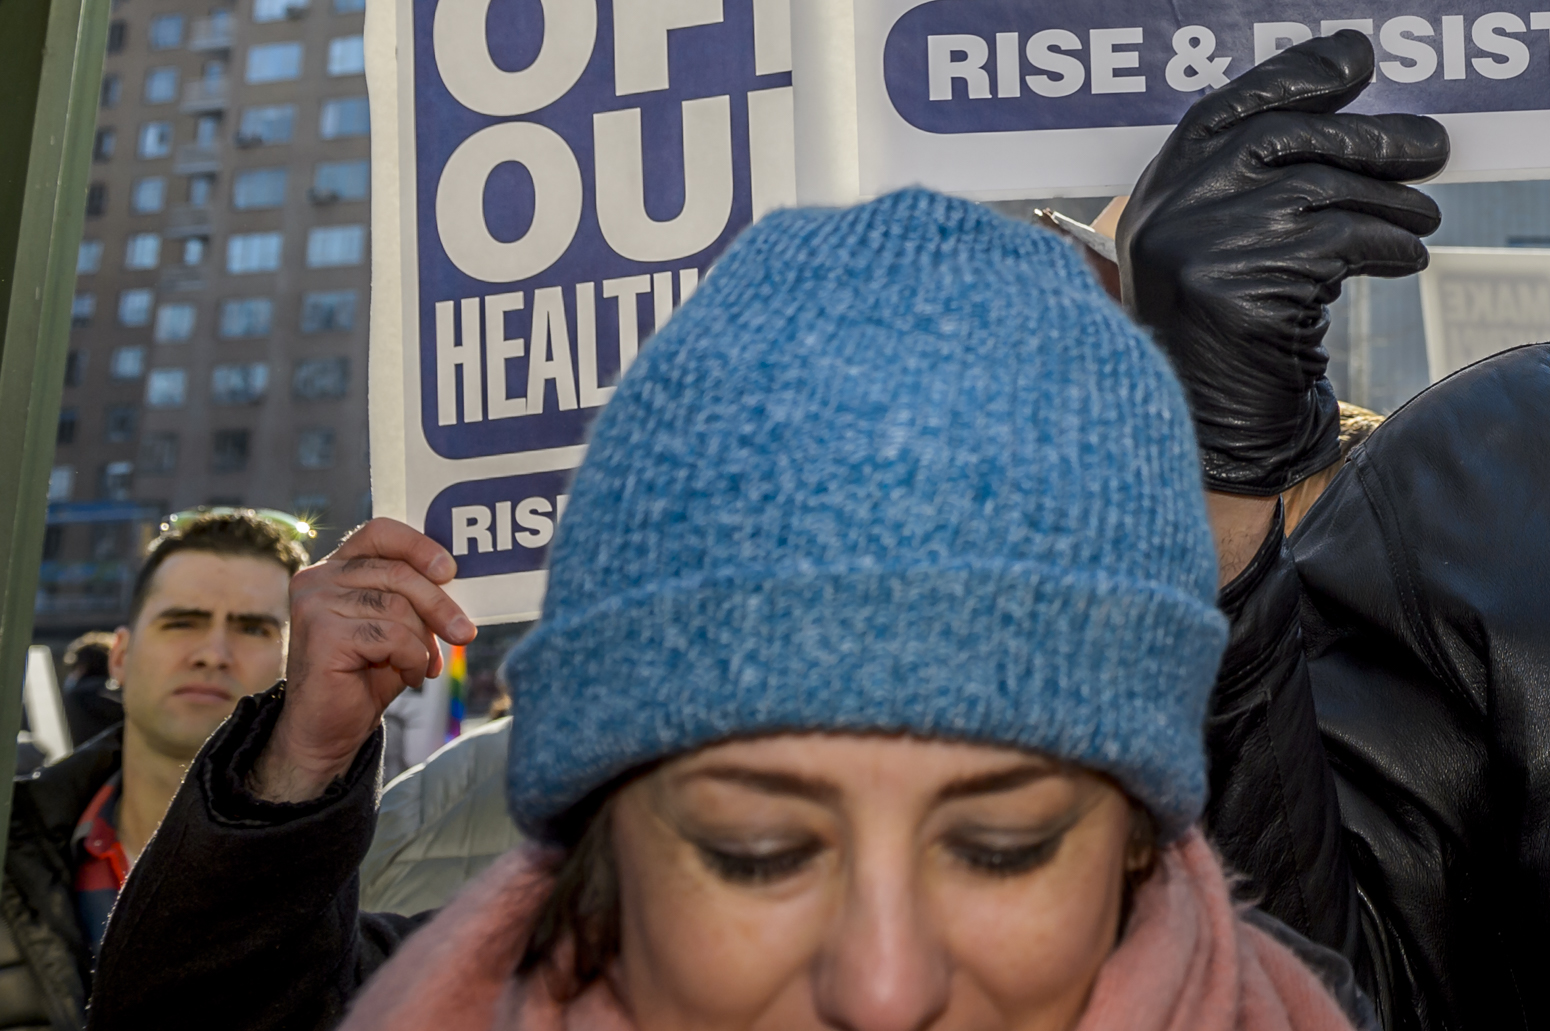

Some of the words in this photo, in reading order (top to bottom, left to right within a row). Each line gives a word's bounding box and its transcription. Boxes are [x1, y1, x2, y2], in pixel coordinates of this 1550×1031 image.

[927, 26, 1146, 101] RISE
[1165, 24, 1233, 93] &
[435, 265, 714, 427] HEALT
[451, 494, 571, 556] RIS
